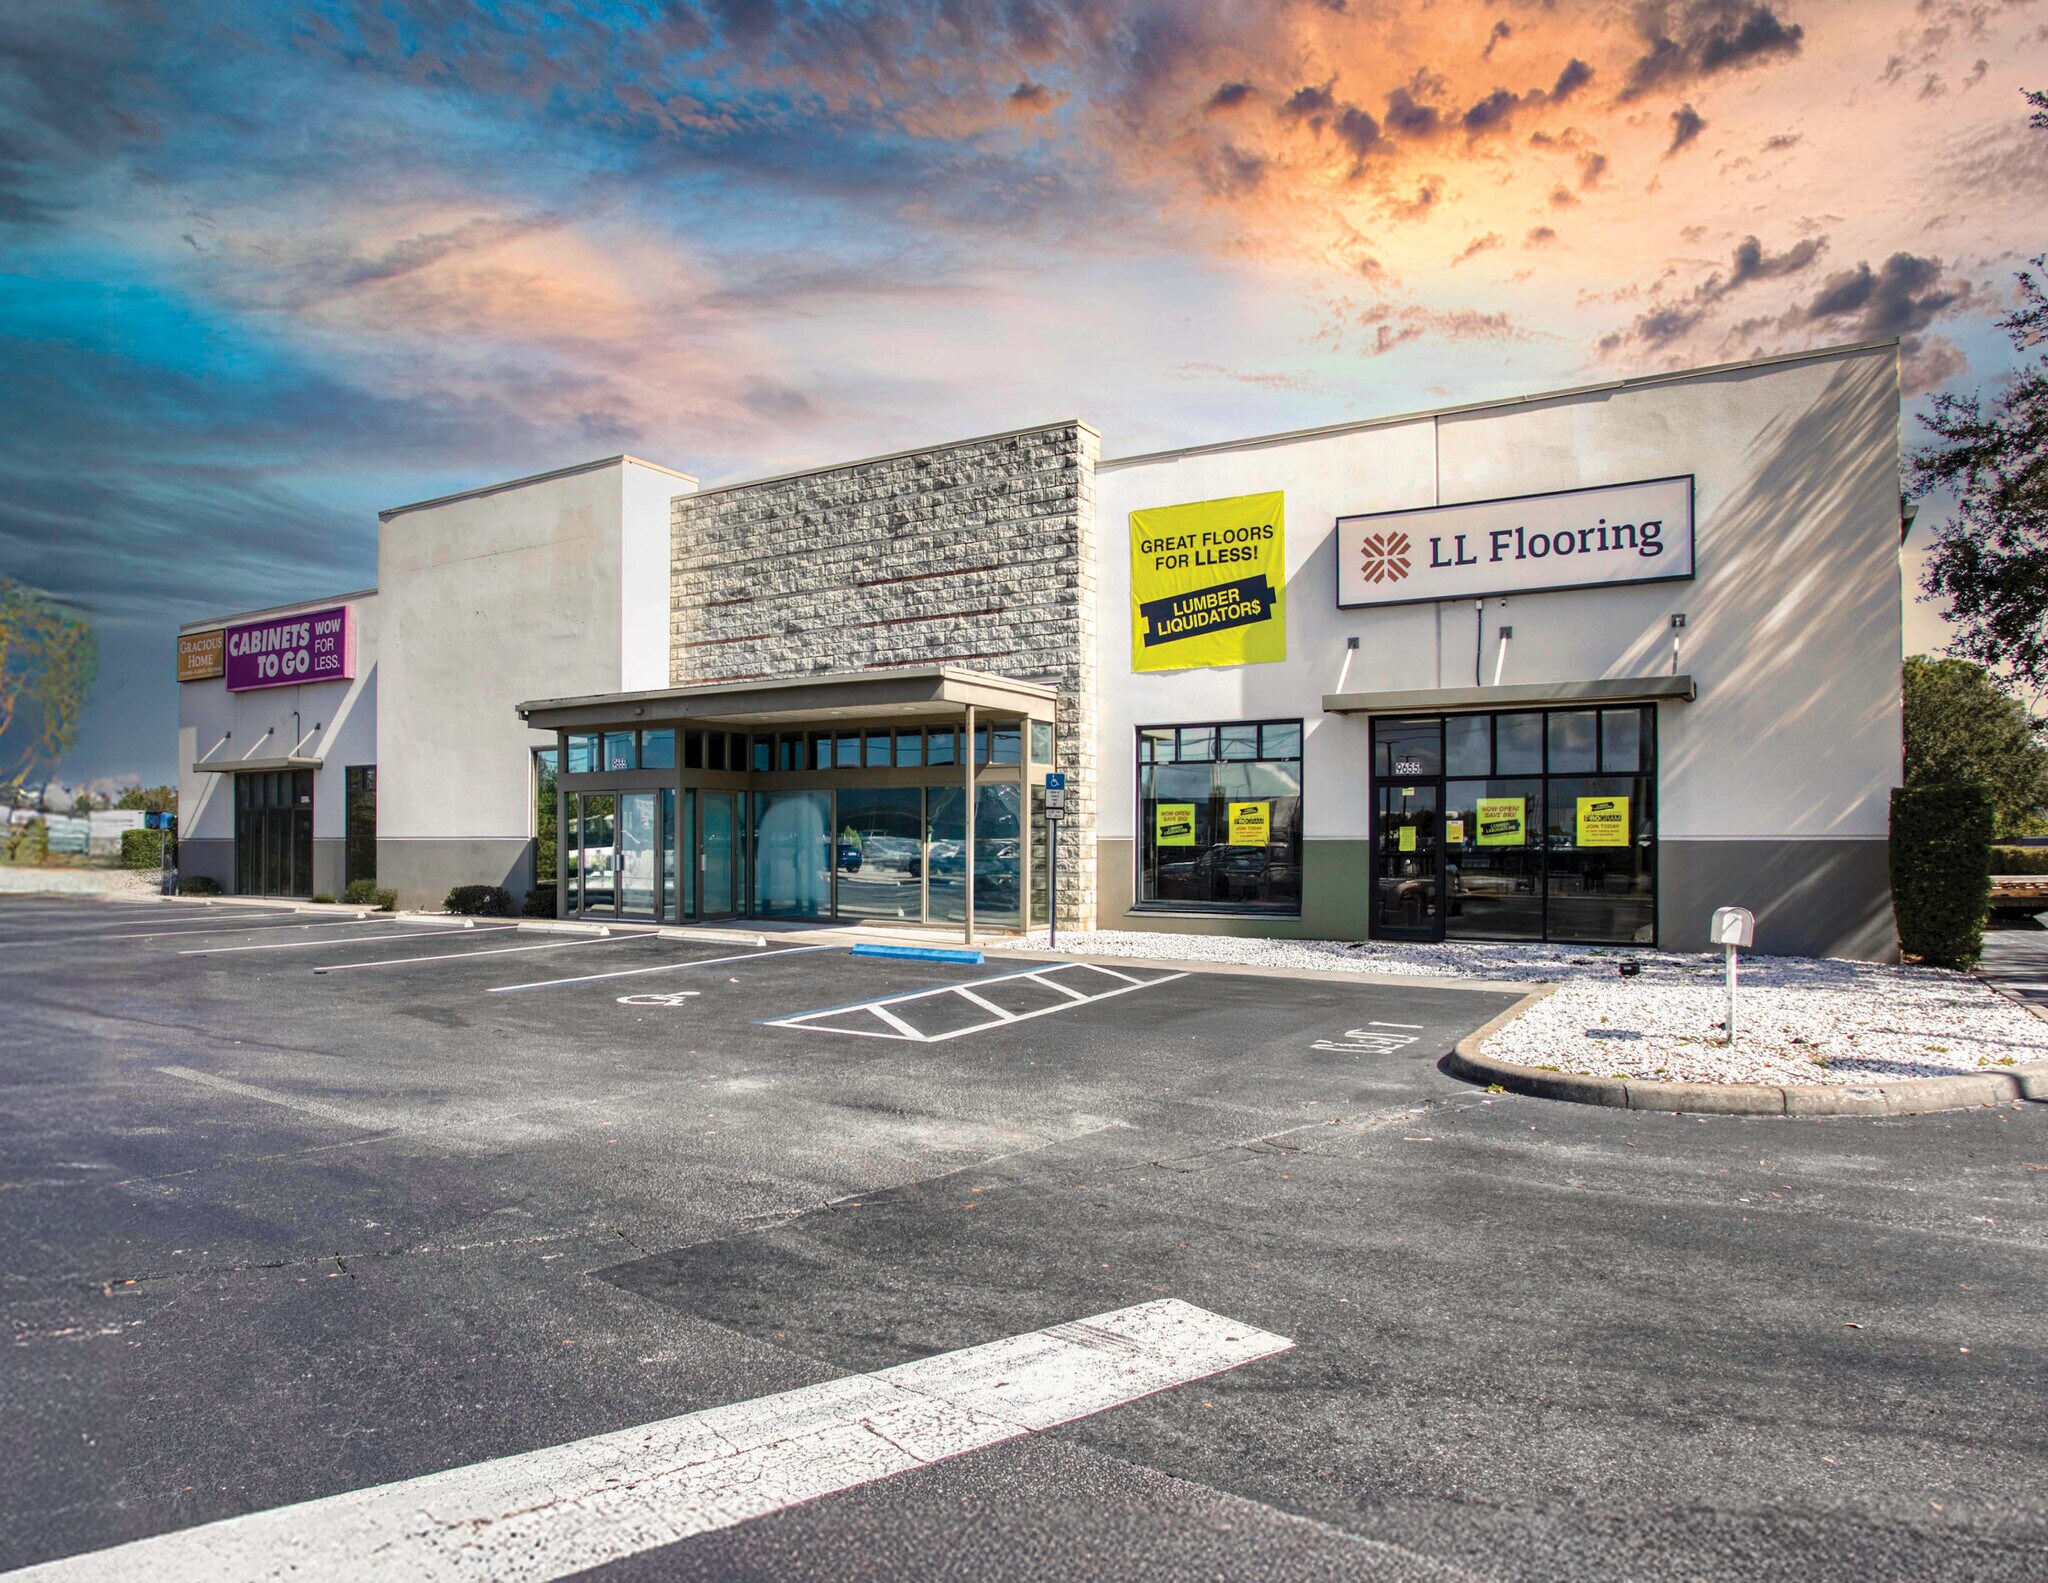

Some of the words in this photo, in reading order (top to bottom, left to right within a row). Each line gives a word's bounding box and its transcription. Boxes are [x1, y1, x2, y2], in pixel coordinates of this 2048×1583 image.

[1141, 534, 1197, 554] GREAT
[1202, 524, 1274, 547] FLOORS
[1429, 534, 1477, 568] LL
[1489, 518, 1664, 563] Flooring
[1155, 554, 1189, 570] FOR
[1195, 545, 1258, 567] LLESS!
[1173, 588, 1240, 617] LUMBER
[229, 622, 310, 657] CABINETS
[314, 618, 341, 636] WOW
[314, 637, 334, 653] FOR
[257, 654, 279, 678] TO
[281, 649, 310, 675] GO
[314, 655, 341, 671] LESS.
